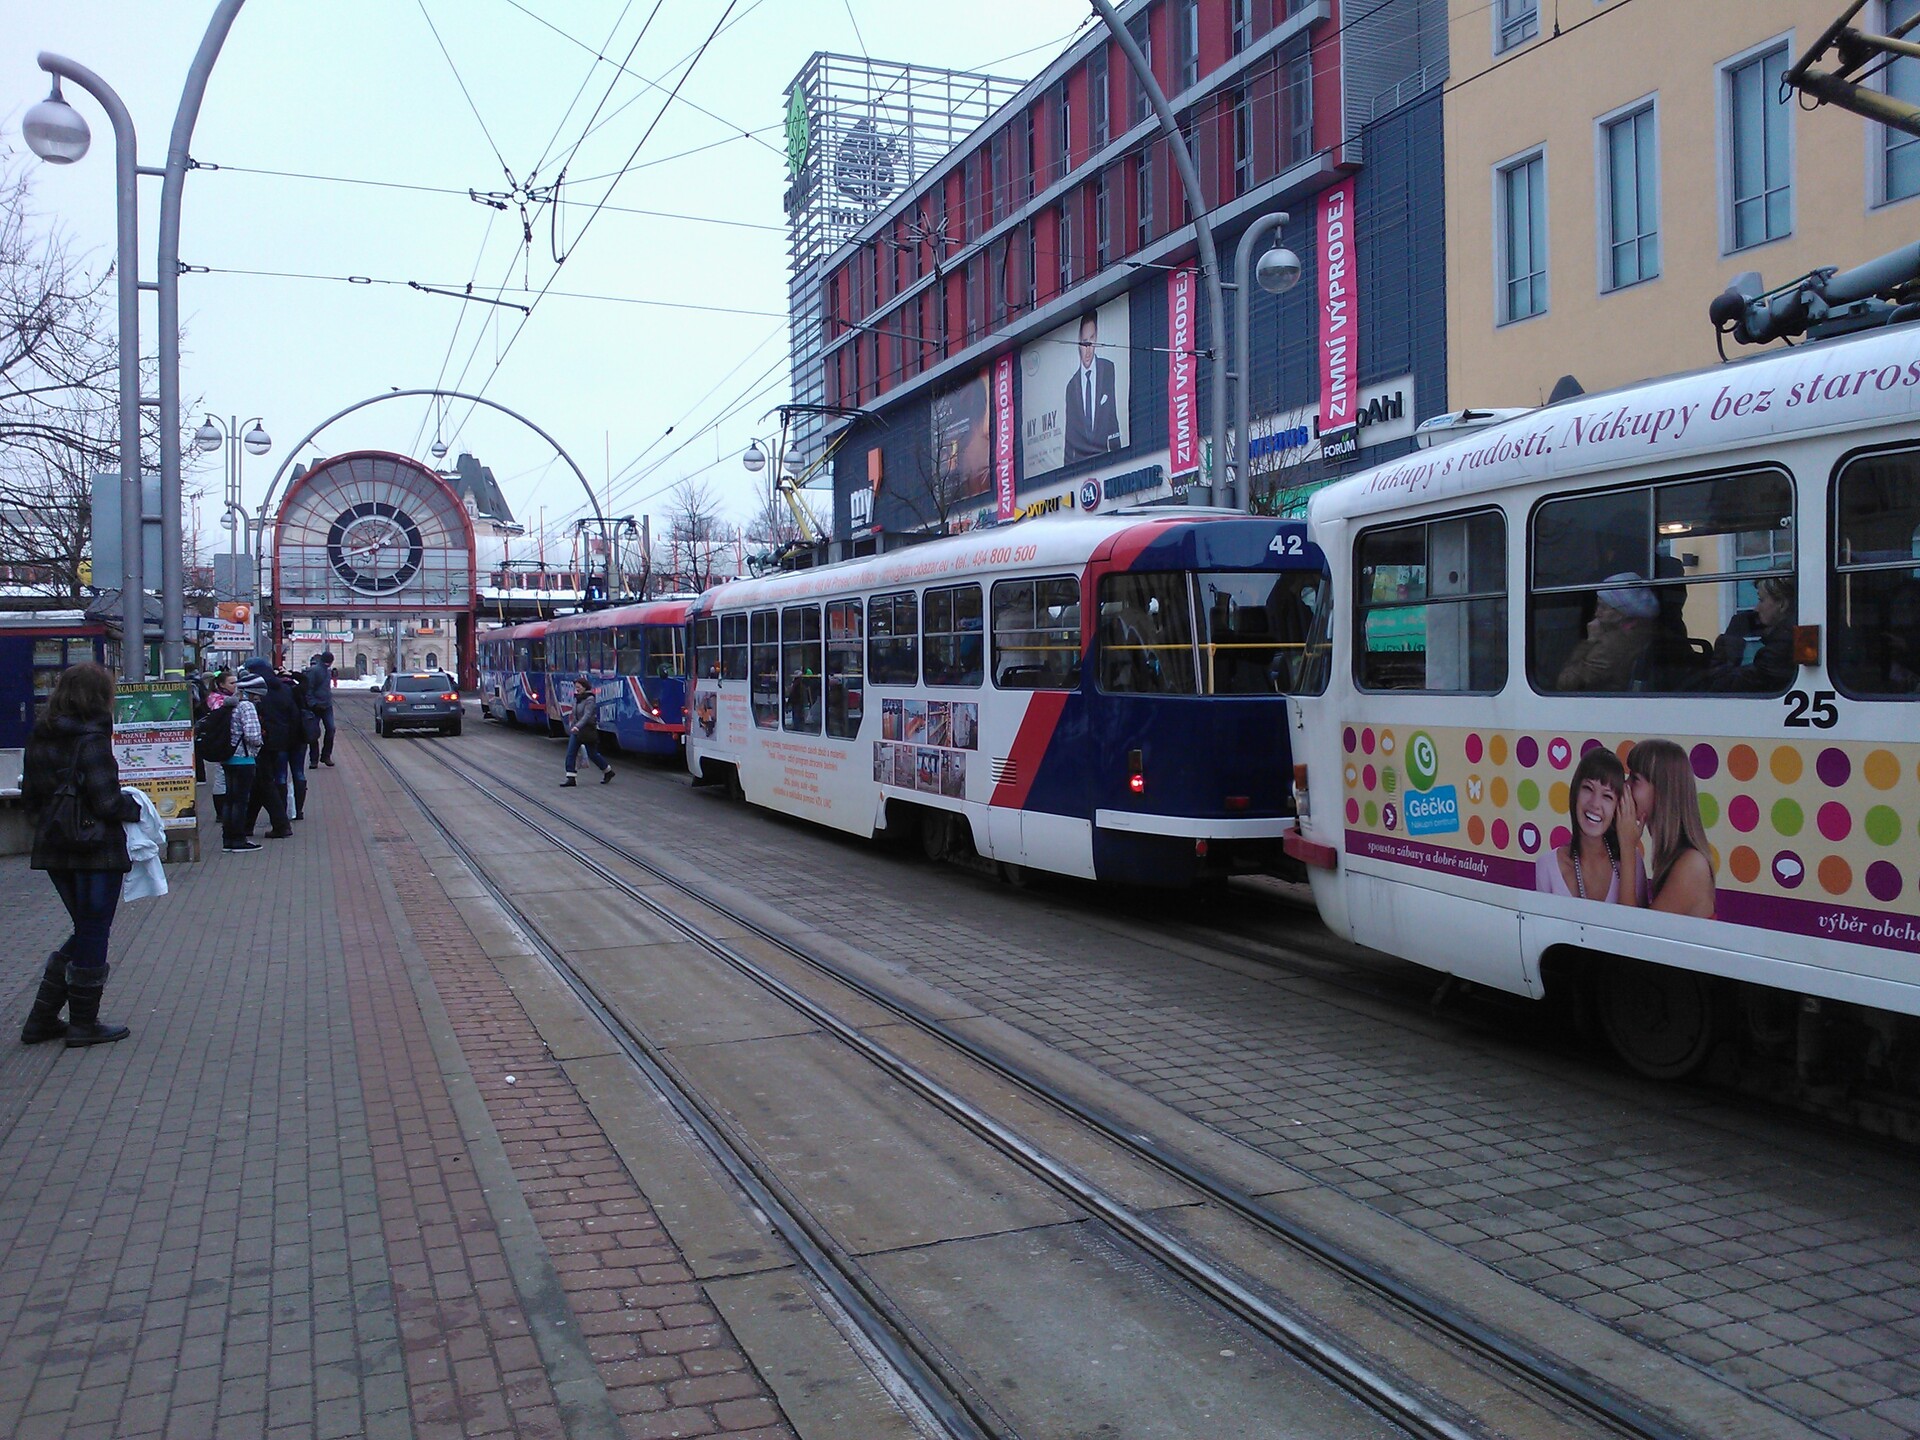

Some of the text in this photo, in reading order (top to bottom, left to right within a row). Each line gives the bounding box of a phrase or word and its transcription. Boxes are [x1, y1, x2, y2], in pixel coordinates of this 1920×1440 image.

[1325, 190, 1347, 420] ZIMNÍ VÝPRODEJ
[1173, 271, 1190, 464] ZIMNÍ VÝPRODEJ
[999, 360, 1010, 513] ZIMNÍ VÝPRODEJ
[1323, 439, 1356, 458] FORUM
[1361, 460, 1441, 495] Nákupy
[1442, 457, 1454, 476] s
[1458, 425, 1555, 472] radostí.
[1559, 401, 1701, 449] Nákupy
[1710, 385, 1776, 422] bez
[1103, 465, 1164, 500] HUMANIC
[989, 548, 1012, 564] 800
[1013, 544, 1037, 562] 500
[1269, 535, 1303, 555] 42
[114, 684, 149, 694] XCALIBUR
[151, 683, 188, 692] EXCALIBUR
[1783, 690, 1838, 728] 25
[1409, 797, 1456, 818] Géčko
[1368, 842, 1396, 854] spousta
[1425, 853, 1432, 863] a
[1432, 851, 1457, 867] dobré
[1458, 857, 1489, 876] nálady
[1817, 912, 1868, 933] výběr
